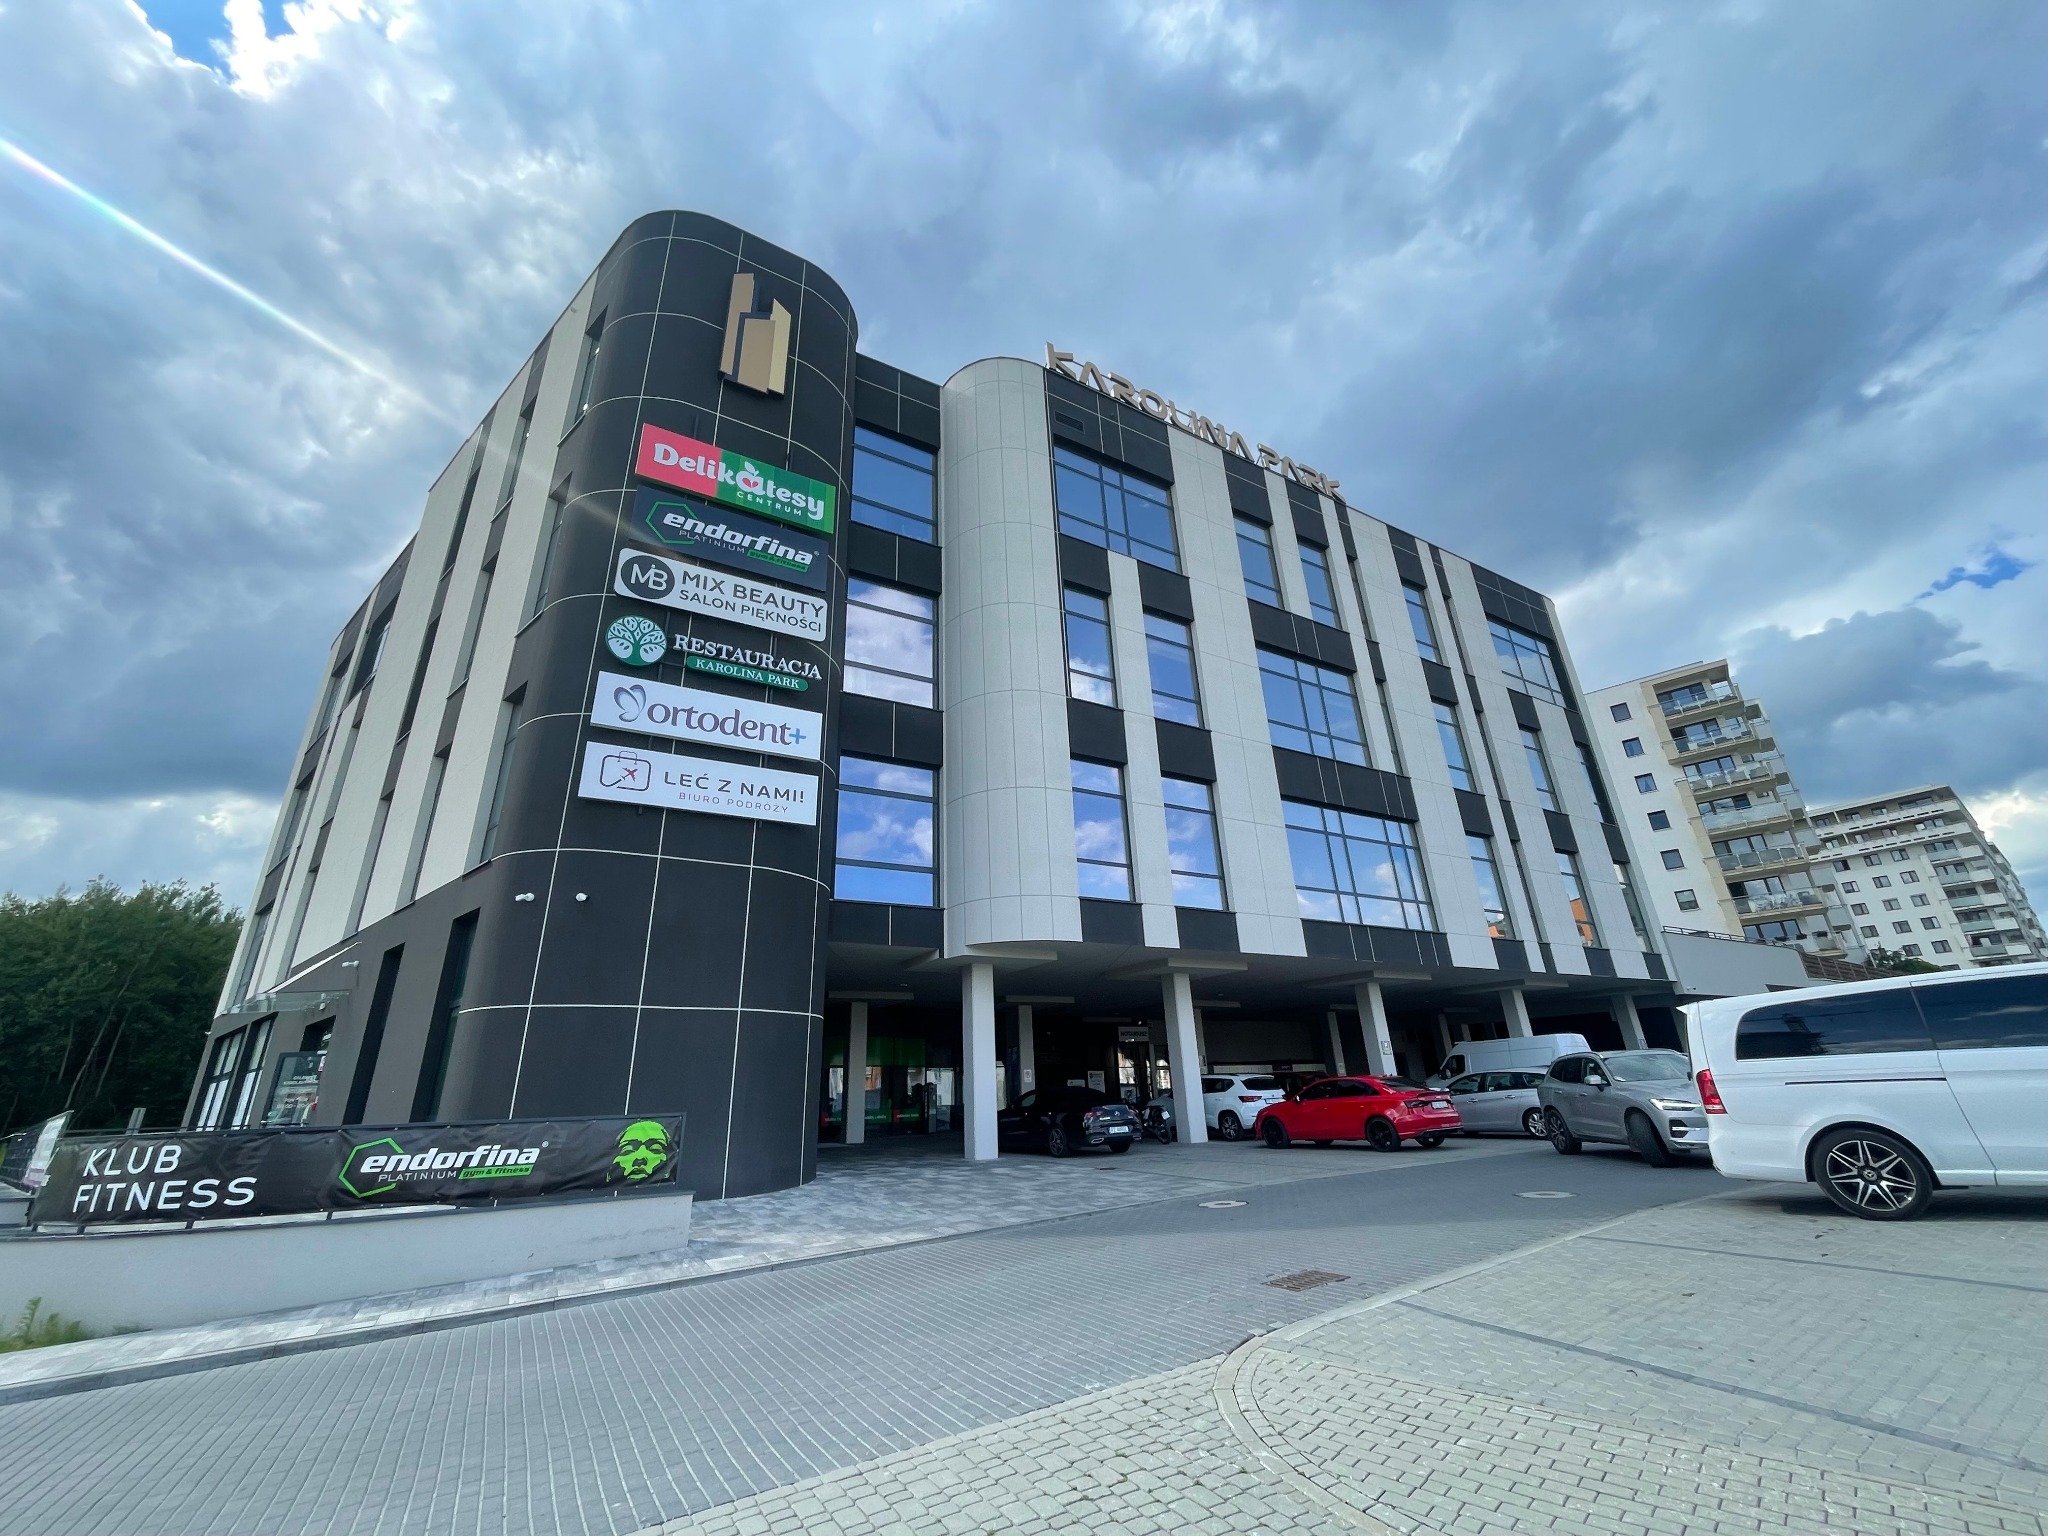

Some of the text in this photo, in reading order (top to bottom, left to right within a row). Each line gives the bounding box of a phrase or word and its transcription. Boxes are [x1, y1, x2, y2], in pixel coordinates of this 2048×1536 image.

[1045, 341, 1346, 503] KAROLINA PARK
[653, 443, 825, 520] Delikatesy
[736, 491, 802, 517] CENTRUM
[663, 512, 814, 566] endorfina
[678, 530, 746, 554] PLATINIUM
[682, 570, 825, 618] MIX BEAUTY
[679, 589, 822, 633] SALON PIĘKNOŚCI
[673, 633, 822, 681] RESTAURACJA
[695, 659, 800, 689] KAROLINA PARK
[663, 771, 805, 803] LEĆ Z NAMI!
[679, 792, 789, 814] BIURO PODRÓŻY
[83, 1145, 182, 1177] KLUB
[360, 1144, 541, 1173] endorfina
[463, 1170, 485, 1178] gym
[494, 1167, 530, 1175] fitness
[378, 1170, 457, 1183] PLATINIUM
[72, 1177, 258, 1213] FITNESS
